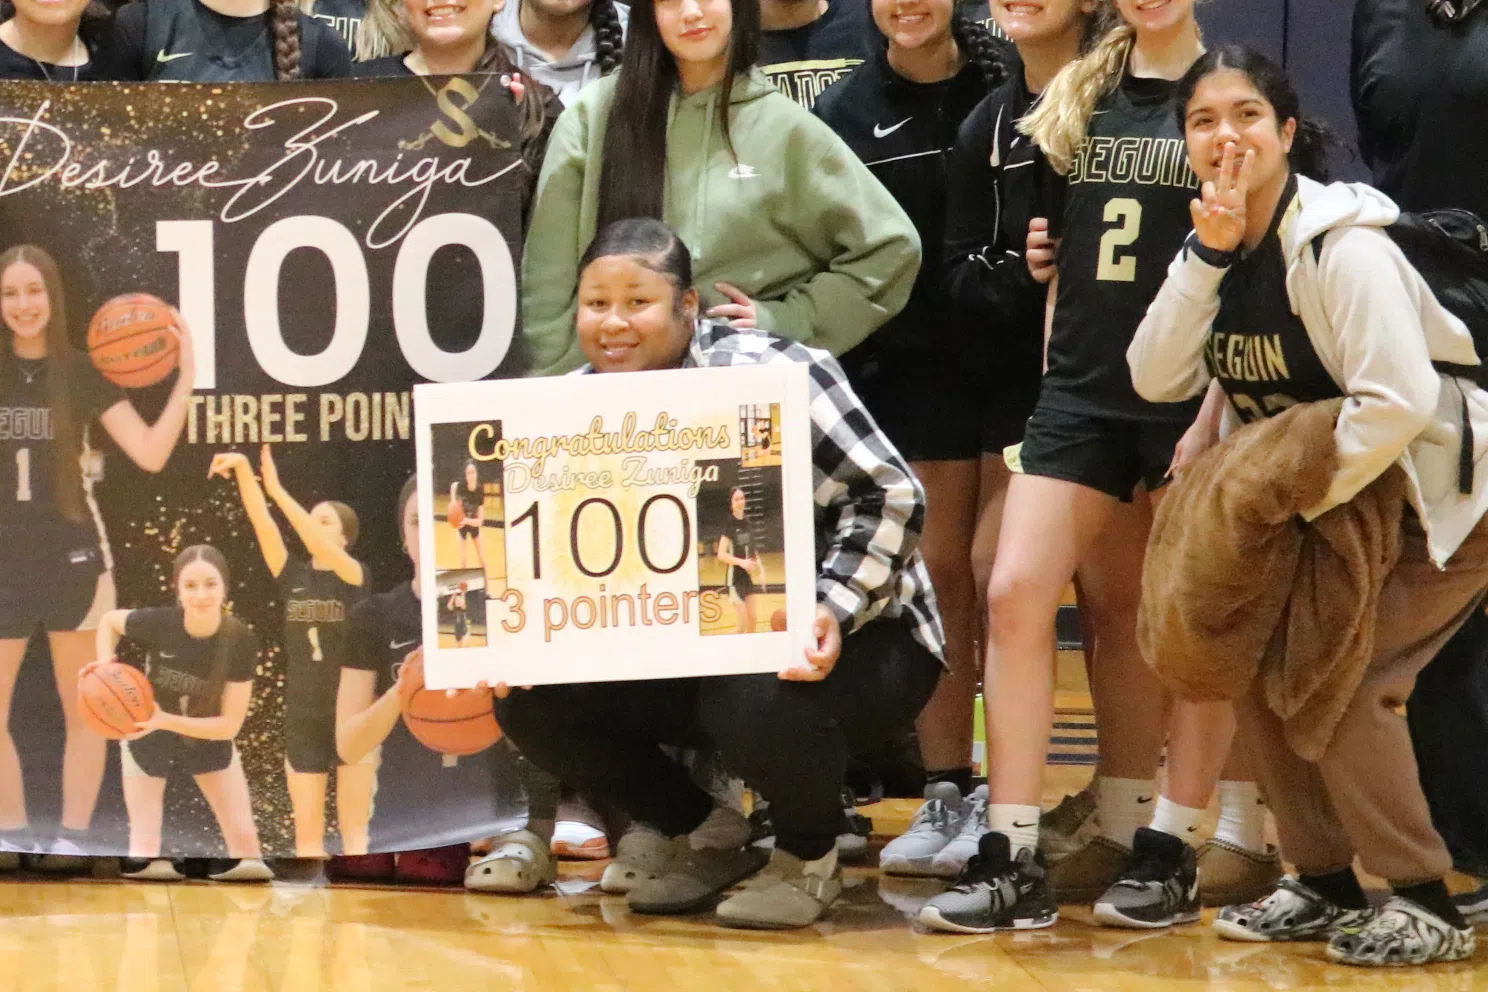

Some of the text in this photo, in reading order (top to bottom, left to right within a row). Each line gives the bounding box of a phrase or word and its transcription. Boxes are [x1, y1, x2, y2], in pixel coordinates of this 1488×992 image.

[218, 96, 523, 250] Zuniga
[1096, 197, 1143, 282] 2
[155, 212, 518, 389] 100
[1205, 332, 1291, 382] EGUIN
[187, 391, 413, 445] THREE POIN
[467, 412, 731, 477] Congratulations
[15, 447, 32, 502] 1
[504, 455, 720, 498] Desiree Zuniga
[510, 492, 692, 581] 100
[500, 582, 723, 643] 3 pointers
